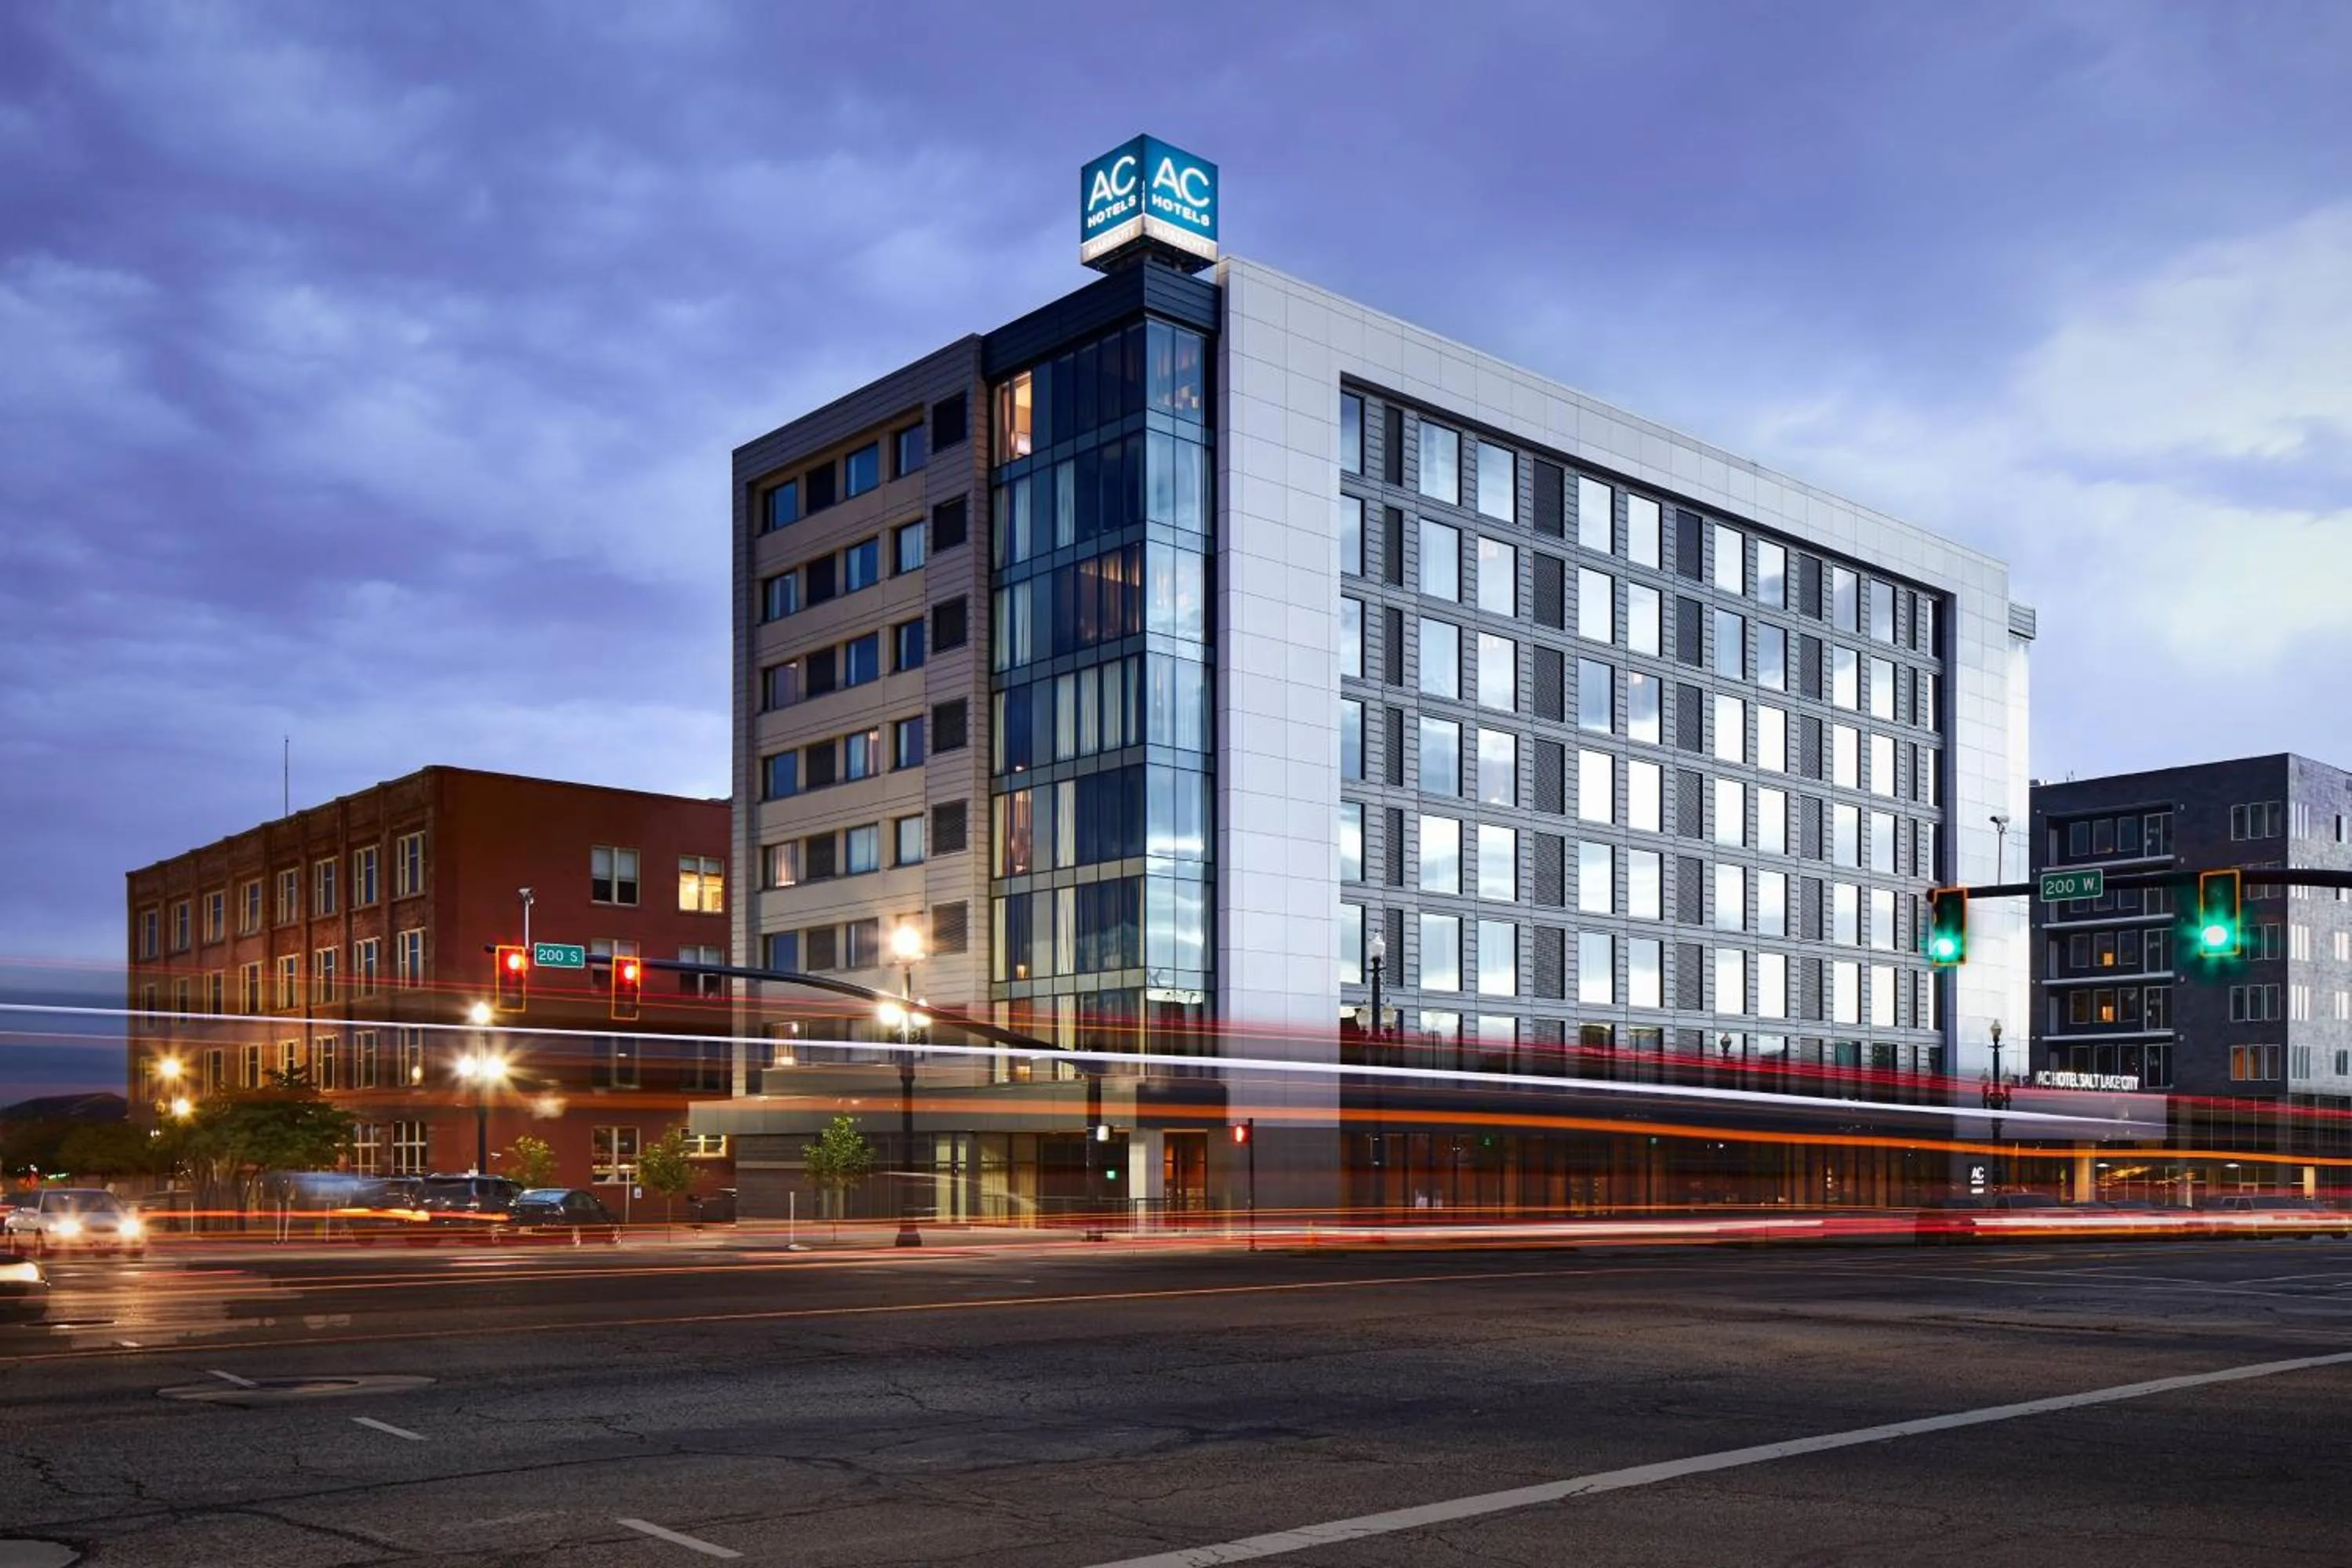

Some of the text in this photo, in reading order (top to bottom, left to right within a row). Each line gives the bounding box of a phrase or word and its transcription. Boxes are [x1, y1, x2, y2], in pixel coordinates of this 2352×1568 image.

[1087, 156, 1136, 211] AC
[1152, 157, 1210, 207] AC
[1087, 195, 1136, 228] HOTELS
[1152, 193, 1210, 227] HOTELS
[2045, 879, 2075, 895] 200
[539, 949, 578, 962] 200 S
[2036, 1070, 2139, 1090] AC HOTEL SALT LAKE CITY
[1971, 1167, 1984, 1179] AC
